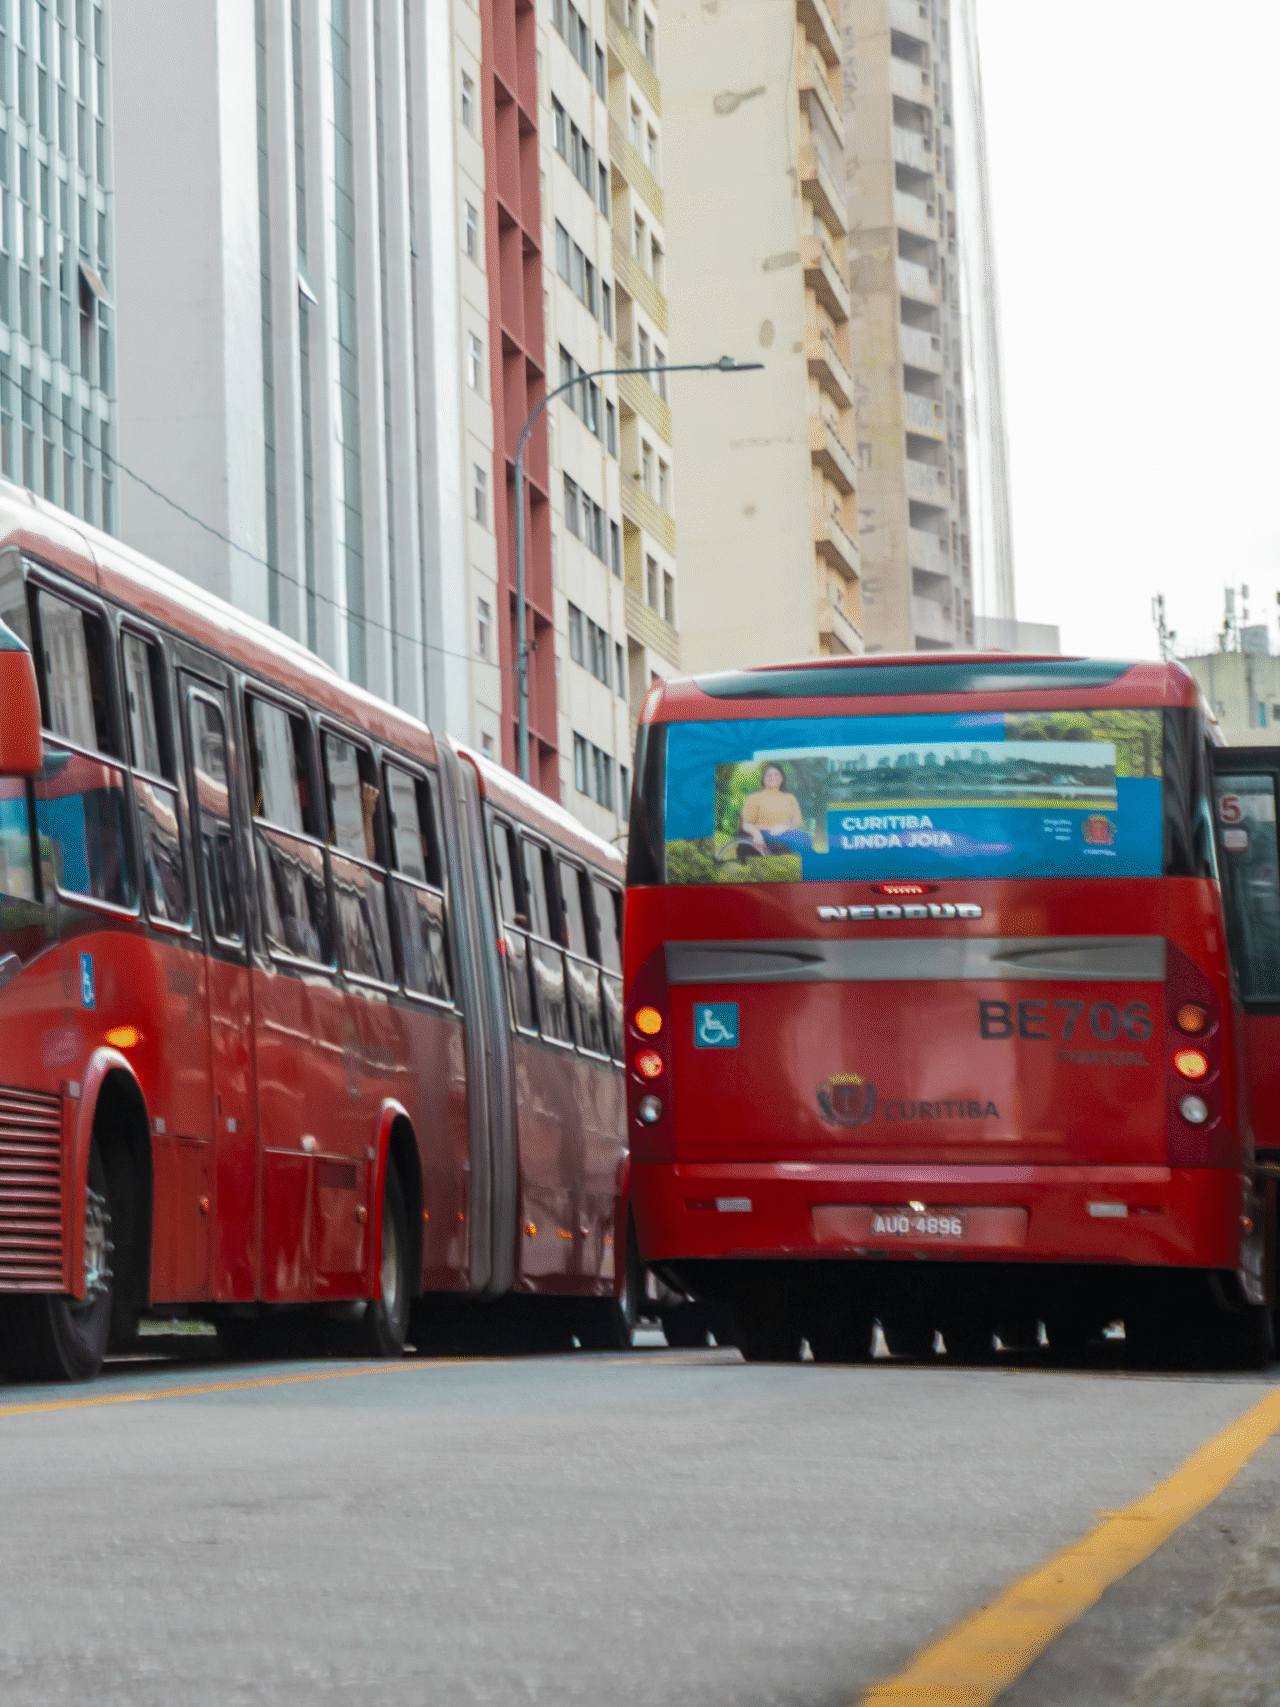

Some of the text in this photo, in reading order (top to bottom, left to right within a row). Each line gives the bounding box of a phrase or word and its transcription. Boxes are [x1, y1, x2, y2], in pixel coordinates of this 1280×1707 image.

[1221, 796, 1241, 821] 5
[841, 815, 934, 831] CURITIBA
[840, 832, 953, 849] LINDA JOIA
[979, 1000, 1154, 1041] BE706
[884, 1100, 1001, 1120] CURITIBA
